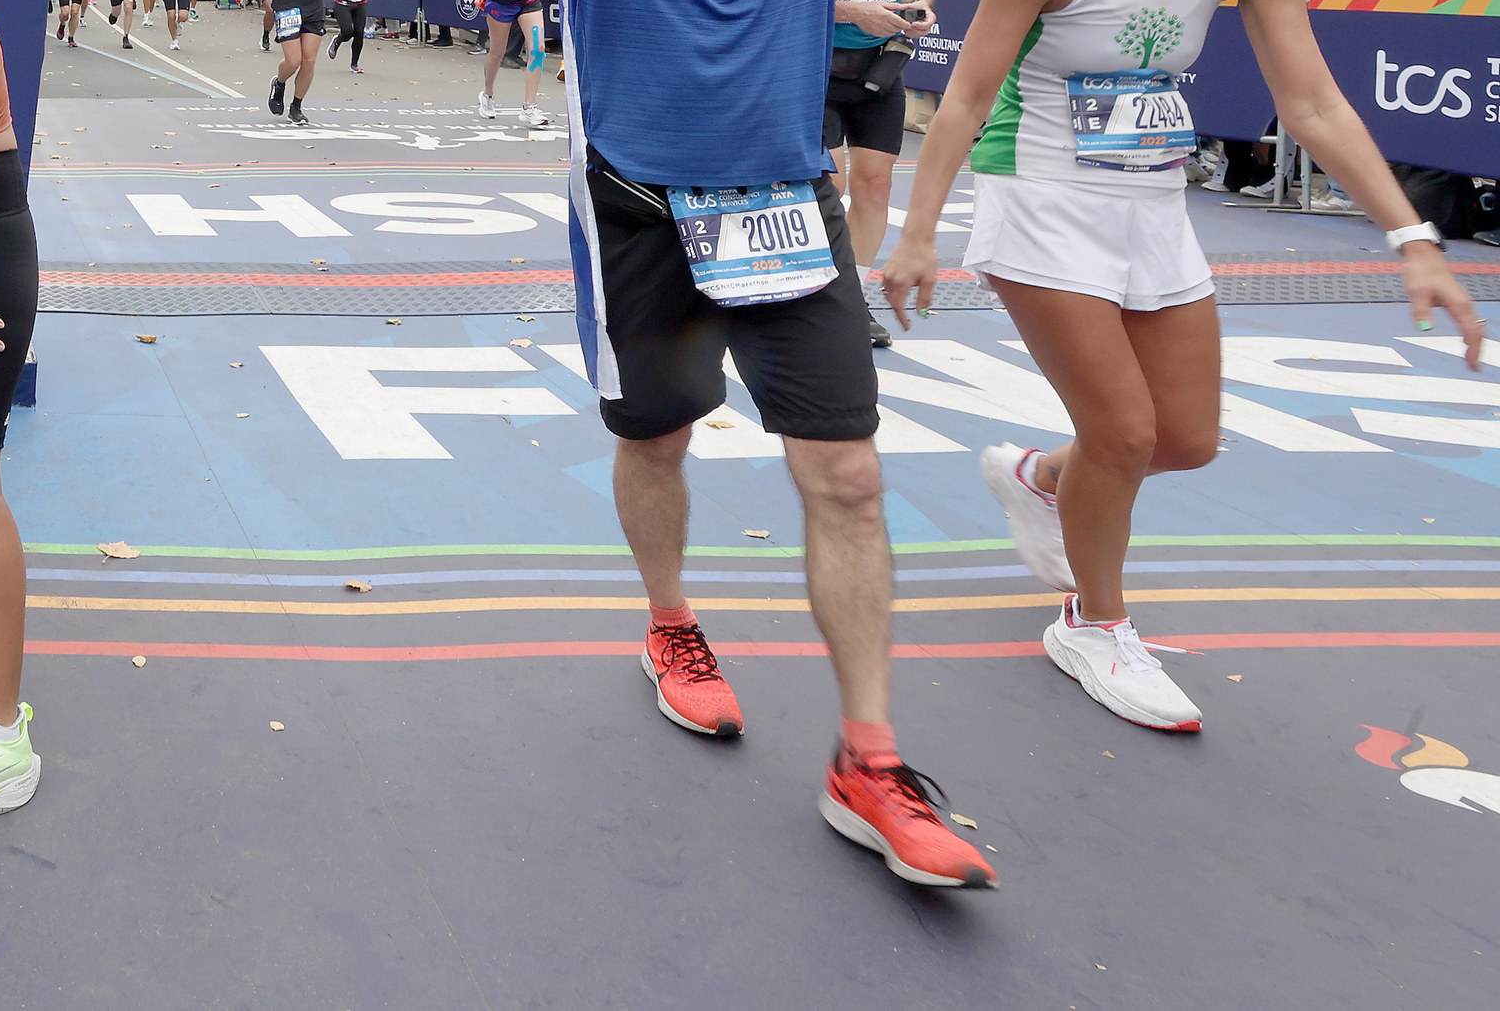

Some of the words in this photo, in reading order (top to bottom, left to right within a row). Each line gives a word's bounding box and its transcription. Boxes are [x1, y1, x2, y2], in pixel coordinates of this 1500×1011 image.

[918, 50, 948, 65] SERVICES
[1082, 76, 1115, 90] tcs
[1374, 49, 1472, 118] tcs
[1086, 99, 1098, 111] 2
[1088, 117, 1102, 130] E
[1140, 136, 1167, 146] 2022
[685, 193, 717, 210] tcs
[771, 191, 795, 200] TATA
[694, 220, 707, 234] 2
[742, 209, 809, 252] 20119
[700, 242, 712, 255] D
[752, 259, 783, 271] 2022
